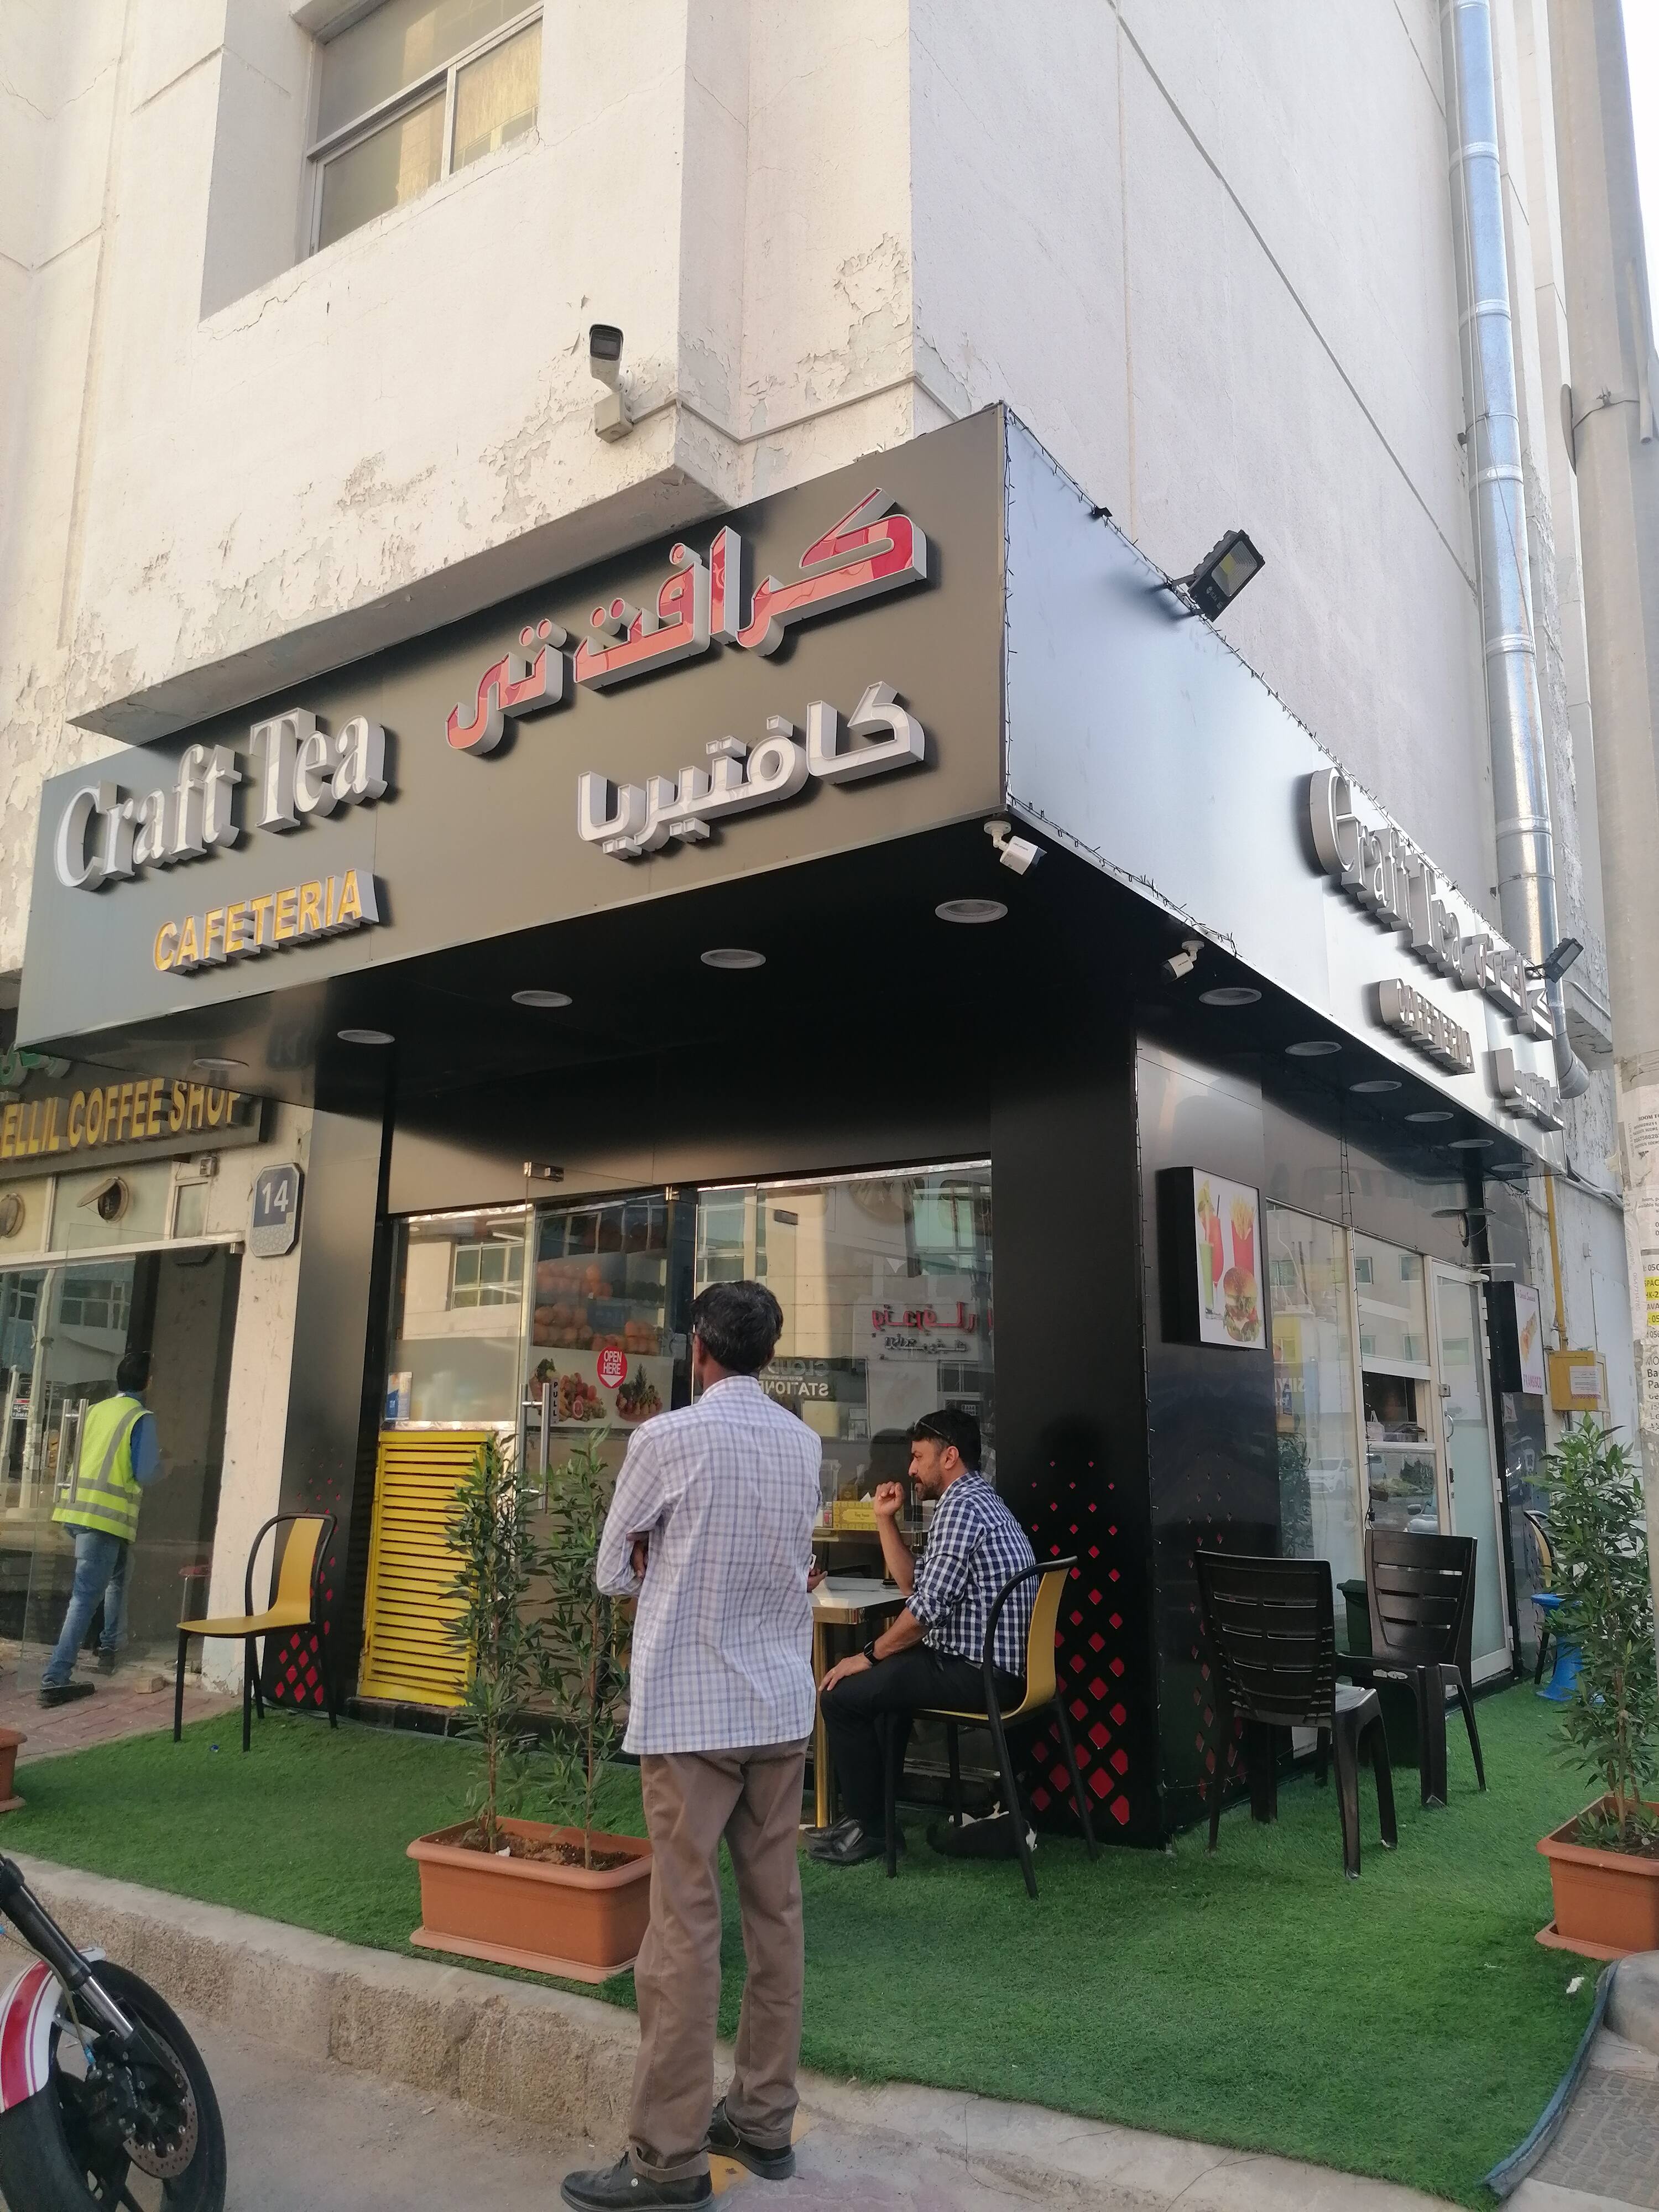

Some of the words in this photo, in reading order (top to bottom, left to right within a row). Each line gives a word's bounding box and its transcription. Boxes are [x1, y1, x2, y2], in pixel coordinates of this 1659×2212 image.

[573, 487, 927, 690] كرافت
[54, 743, 242, 891] Craft
[249, 707, 389, 834] Tea
[578, 681, 925, 860] كافتيريا
[1309, 766, 1415, 933] Craft
[153, 869, 379, 975] CAFETERIA
[68, 1077, 166, 1147] COFFEE
[261, 1179, 289, 1214] 14
[603, 1350, 622, 1363] OPEN
[603, 1363, 621, 1375] HERE
